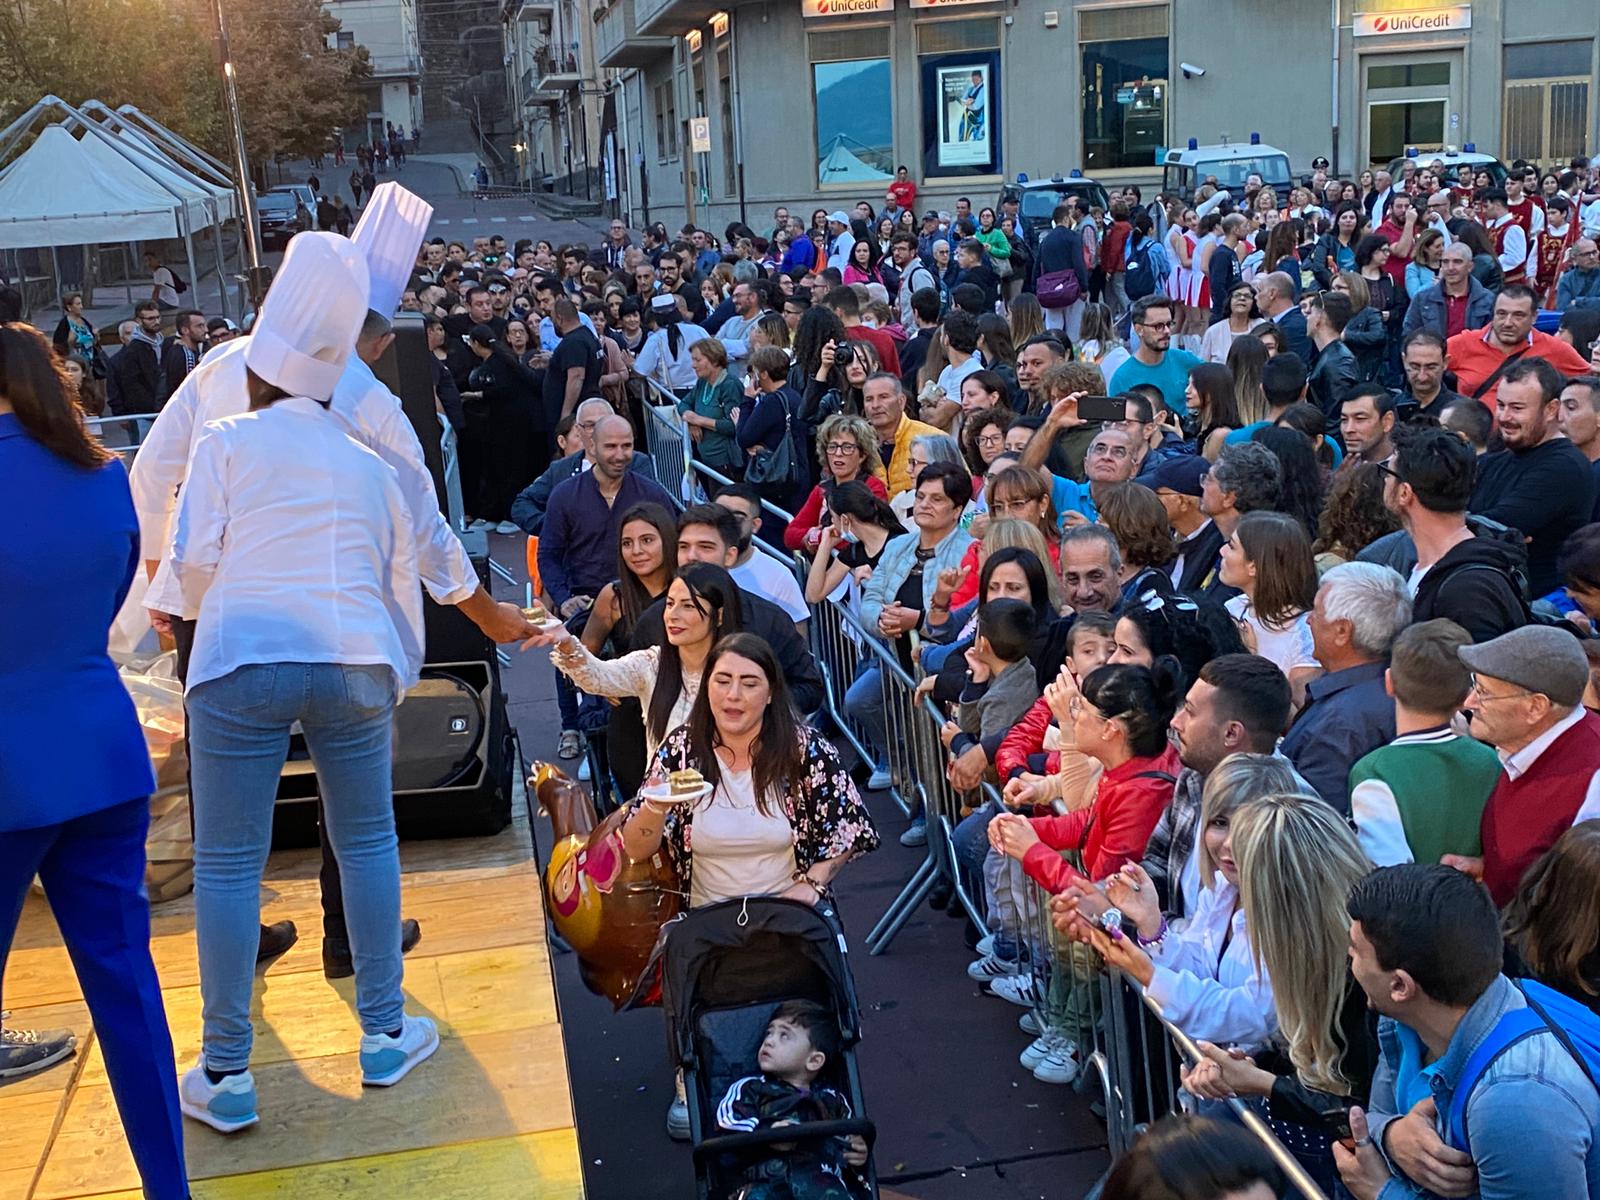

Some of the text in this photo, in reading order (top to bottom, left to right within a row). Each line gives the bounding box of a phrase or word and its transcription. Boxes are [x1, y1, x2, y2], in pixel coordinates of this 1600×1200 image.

[830, 0, 879, 12] UniCredit
[1390, 14, 1450, 30] UniCredit
[696, 125, 705, 138] P
